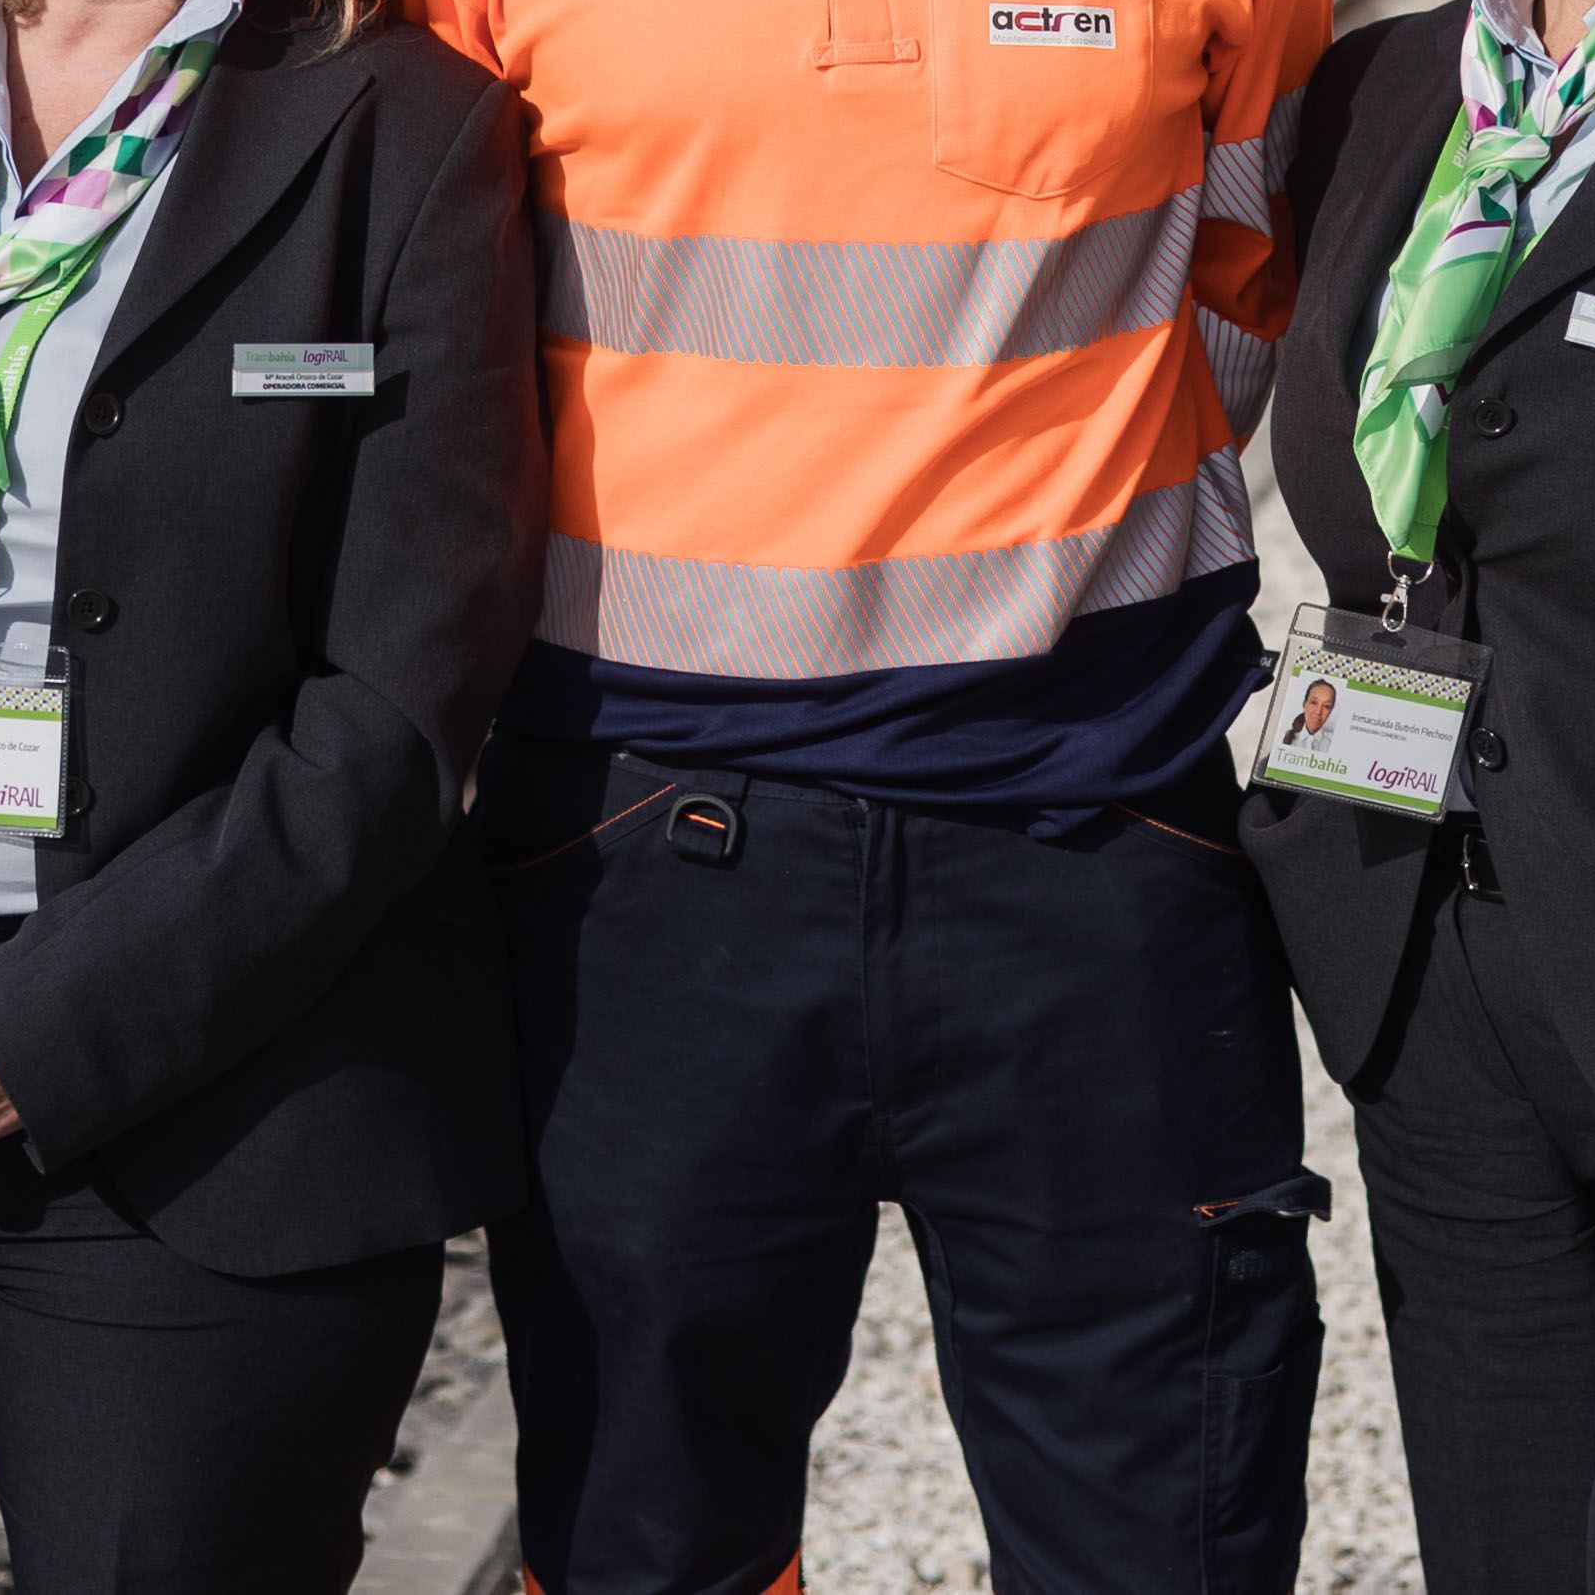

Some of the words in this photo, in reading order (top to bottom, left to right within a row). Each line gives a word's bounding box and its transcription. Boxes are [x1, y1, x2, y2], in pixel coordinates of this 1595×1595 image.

[992, 7, 1111, 34] actren
[303, 350, 348, 365] logiRAIL
[263, 382, 306, 390] OPERADORA
[306, 382, 347, 390] COMERCIAL
[1352, 712, 1393, 729] Inmaculada
[7, 741, 17, 751] de
[18, 742, 40, 752] Cozar
[1277, 747, 1348, 776] Trambahía
[1367, 760, 1439, 795] logiRAIL
